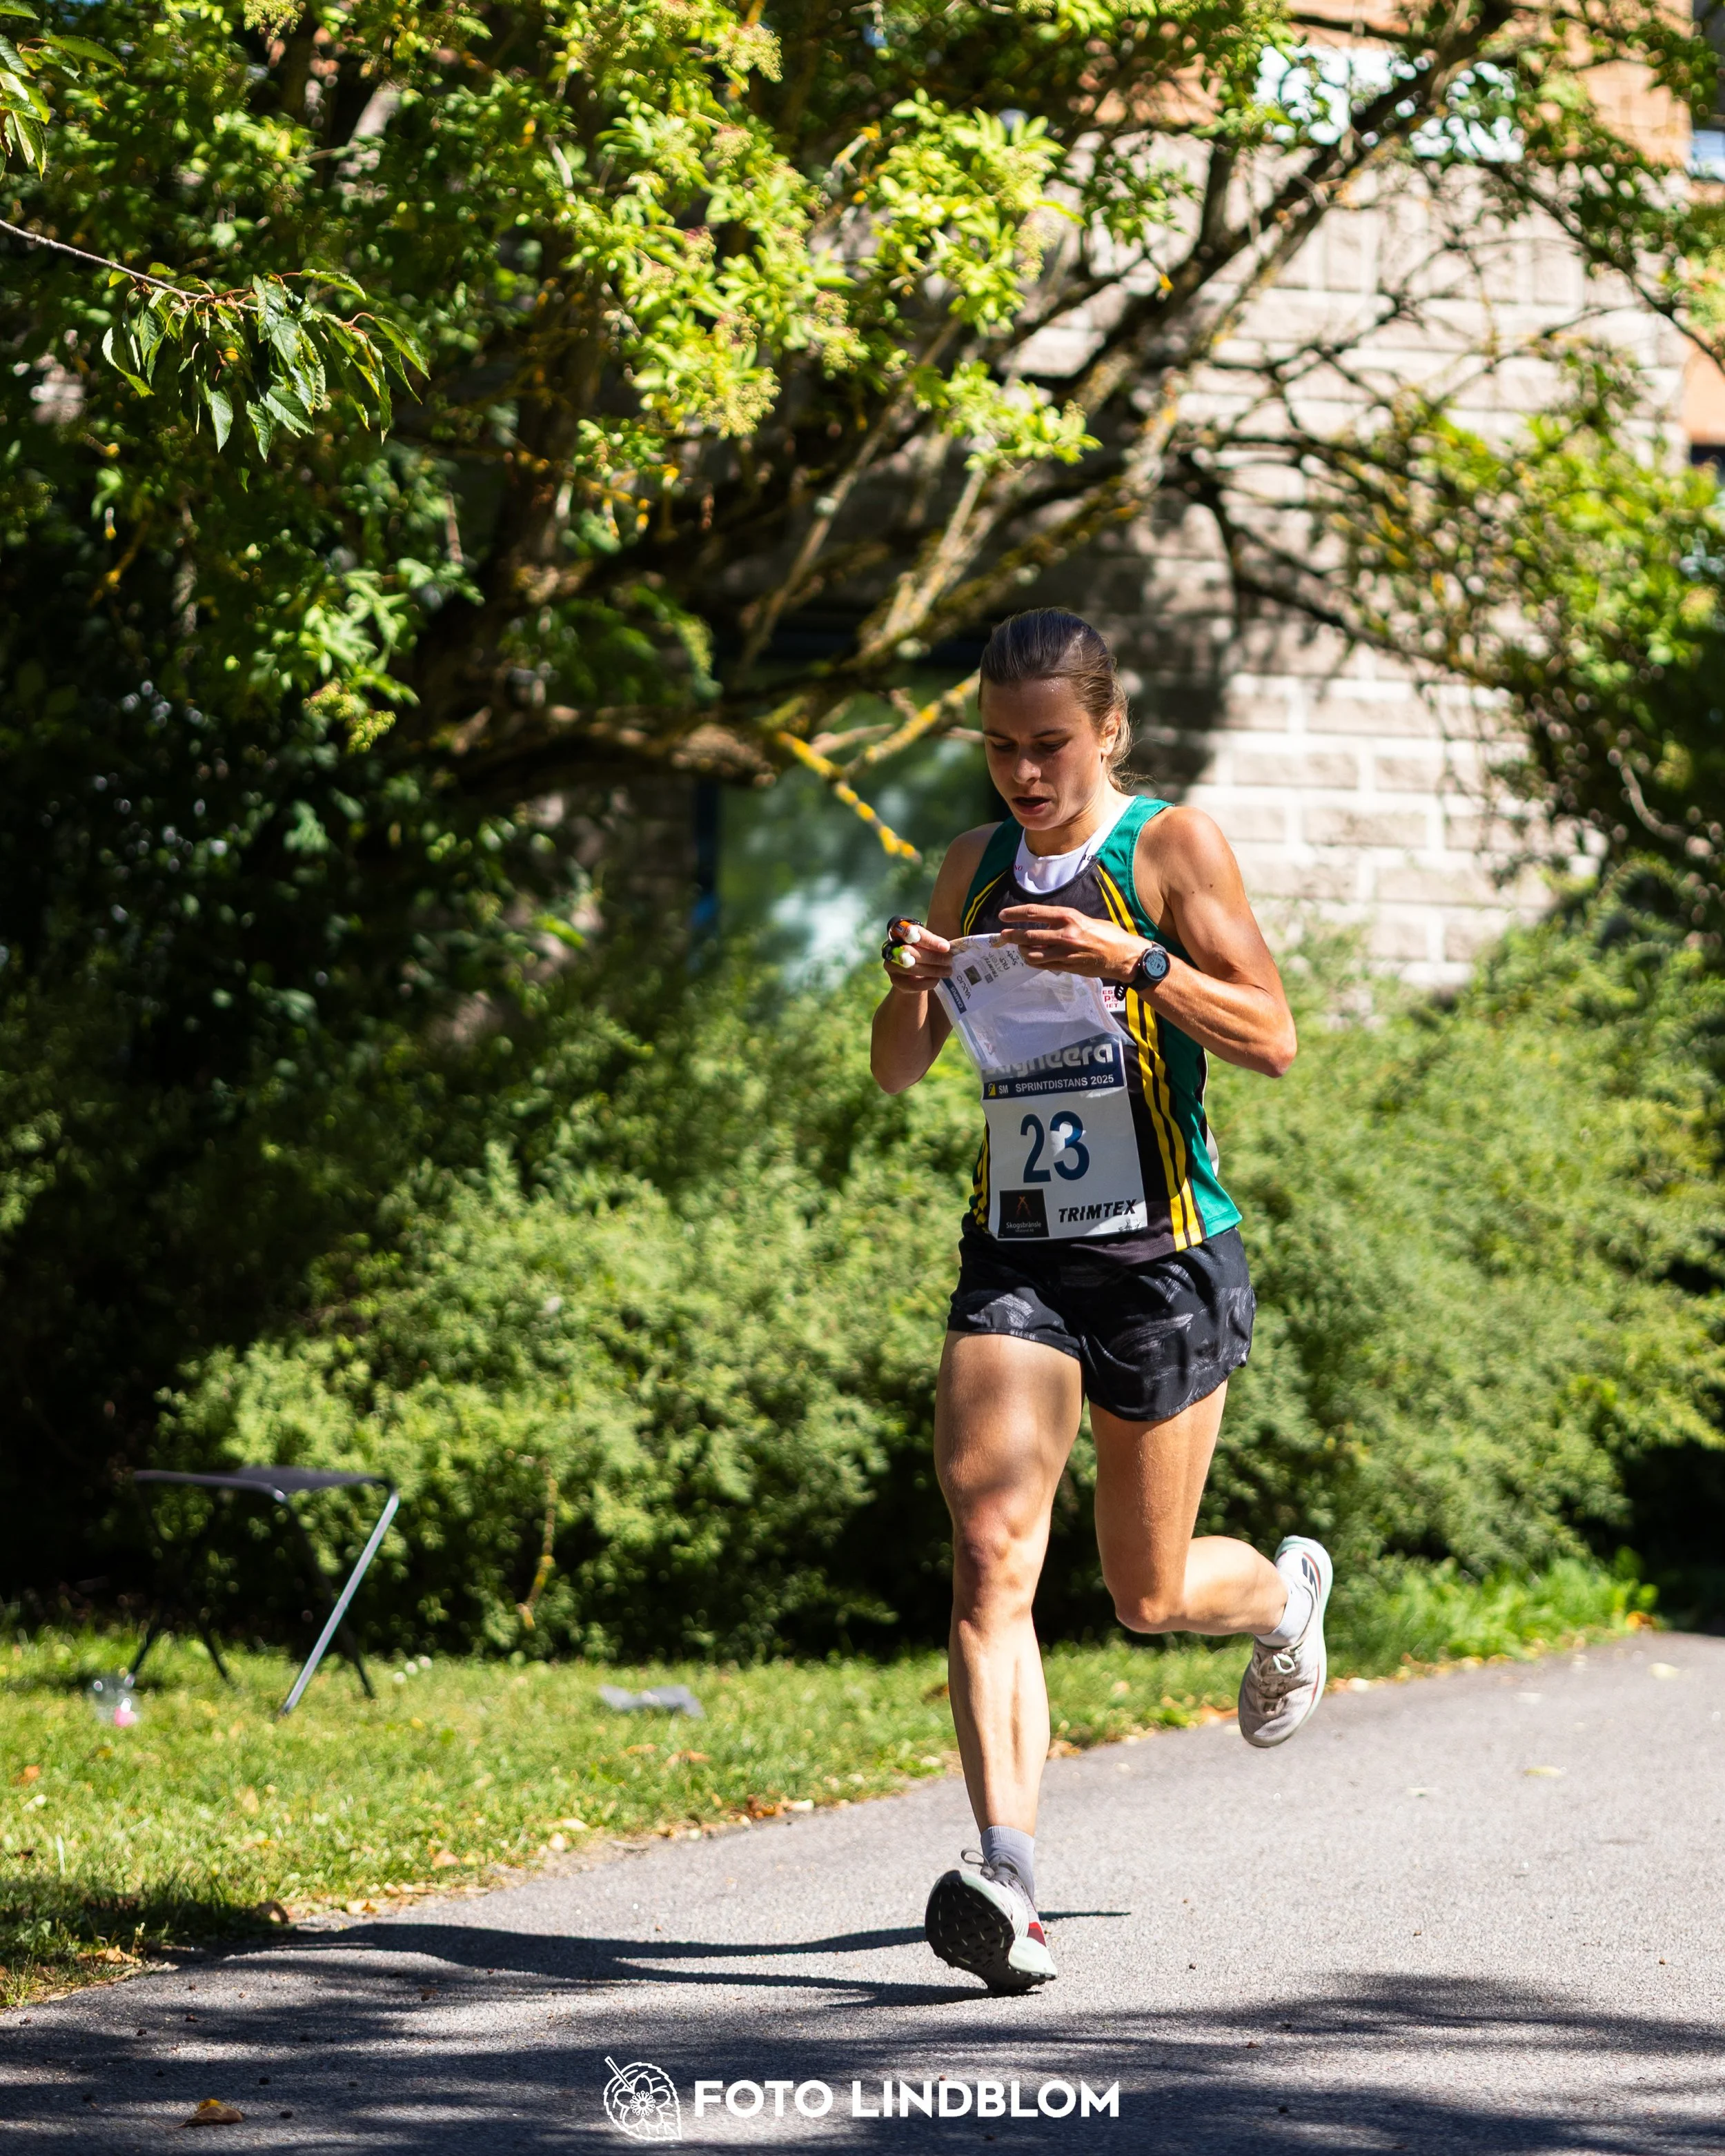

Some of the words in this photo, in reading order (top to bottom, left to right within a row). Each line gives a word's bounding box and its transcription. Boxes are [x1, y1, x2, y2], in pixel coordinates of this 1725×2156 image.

[950, 987, 963, 1008] CAMPUS
[998, 1085, 1008, 1094] SM
[1016, 1077, 1088, 1093] SPRINTDISTANS
[1091, 1074, 1114, 1086] 2025
[1021, 1110, 1090, 1183] 23
[1058, 1199, 1137, 1223] TRIMTEX
